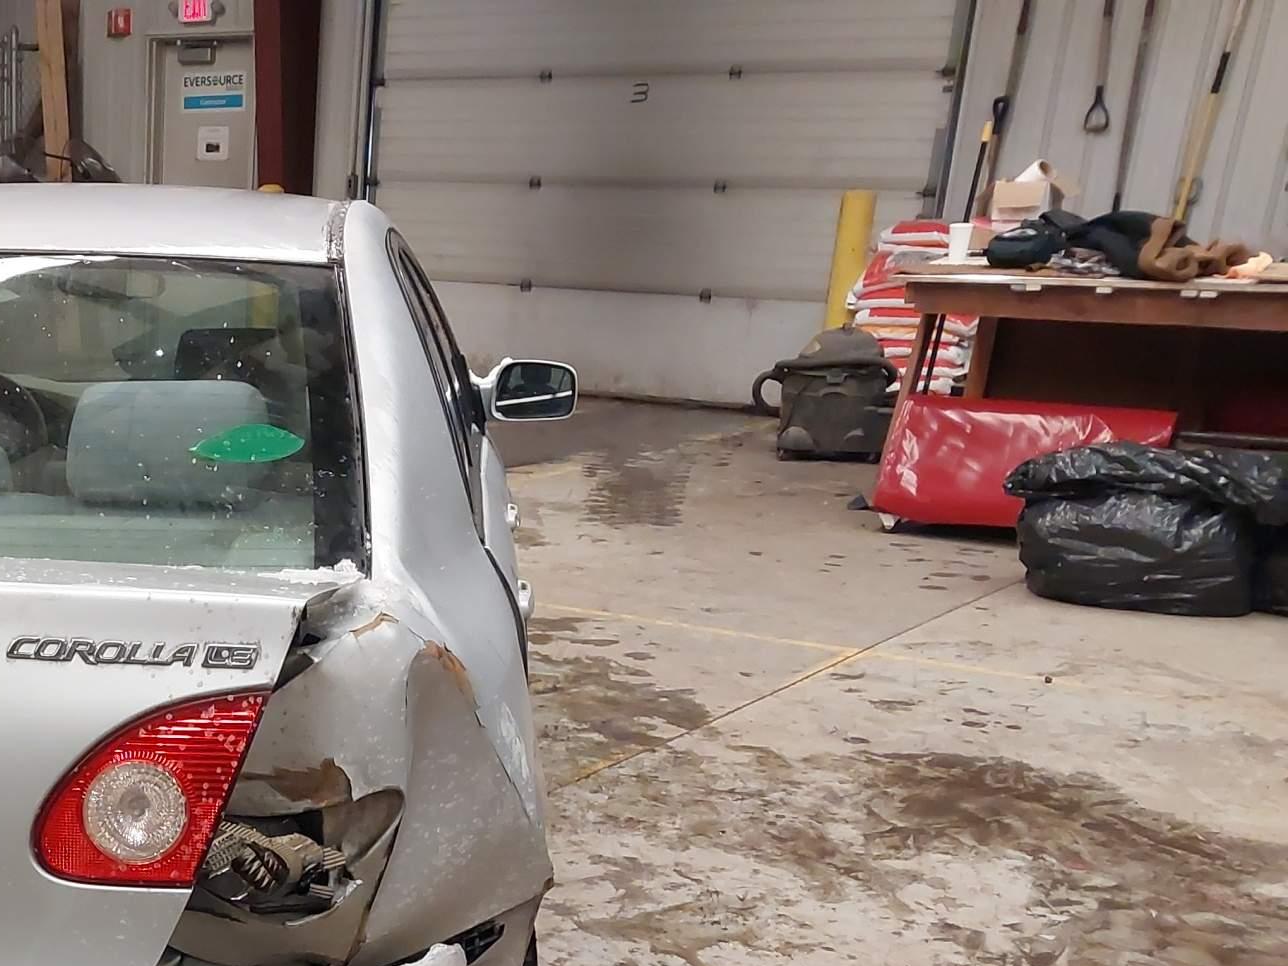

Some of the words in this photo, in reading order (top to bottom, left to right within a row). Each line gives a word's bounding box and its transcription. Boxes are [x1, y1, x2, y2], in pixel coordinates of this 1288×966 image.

[183, 74, 244, 88] EVERSOURCE
[629, 82, 650, 104] 3
[5, 635, 198, 668] COROLLA
[201, 641, 261, 670] LE
